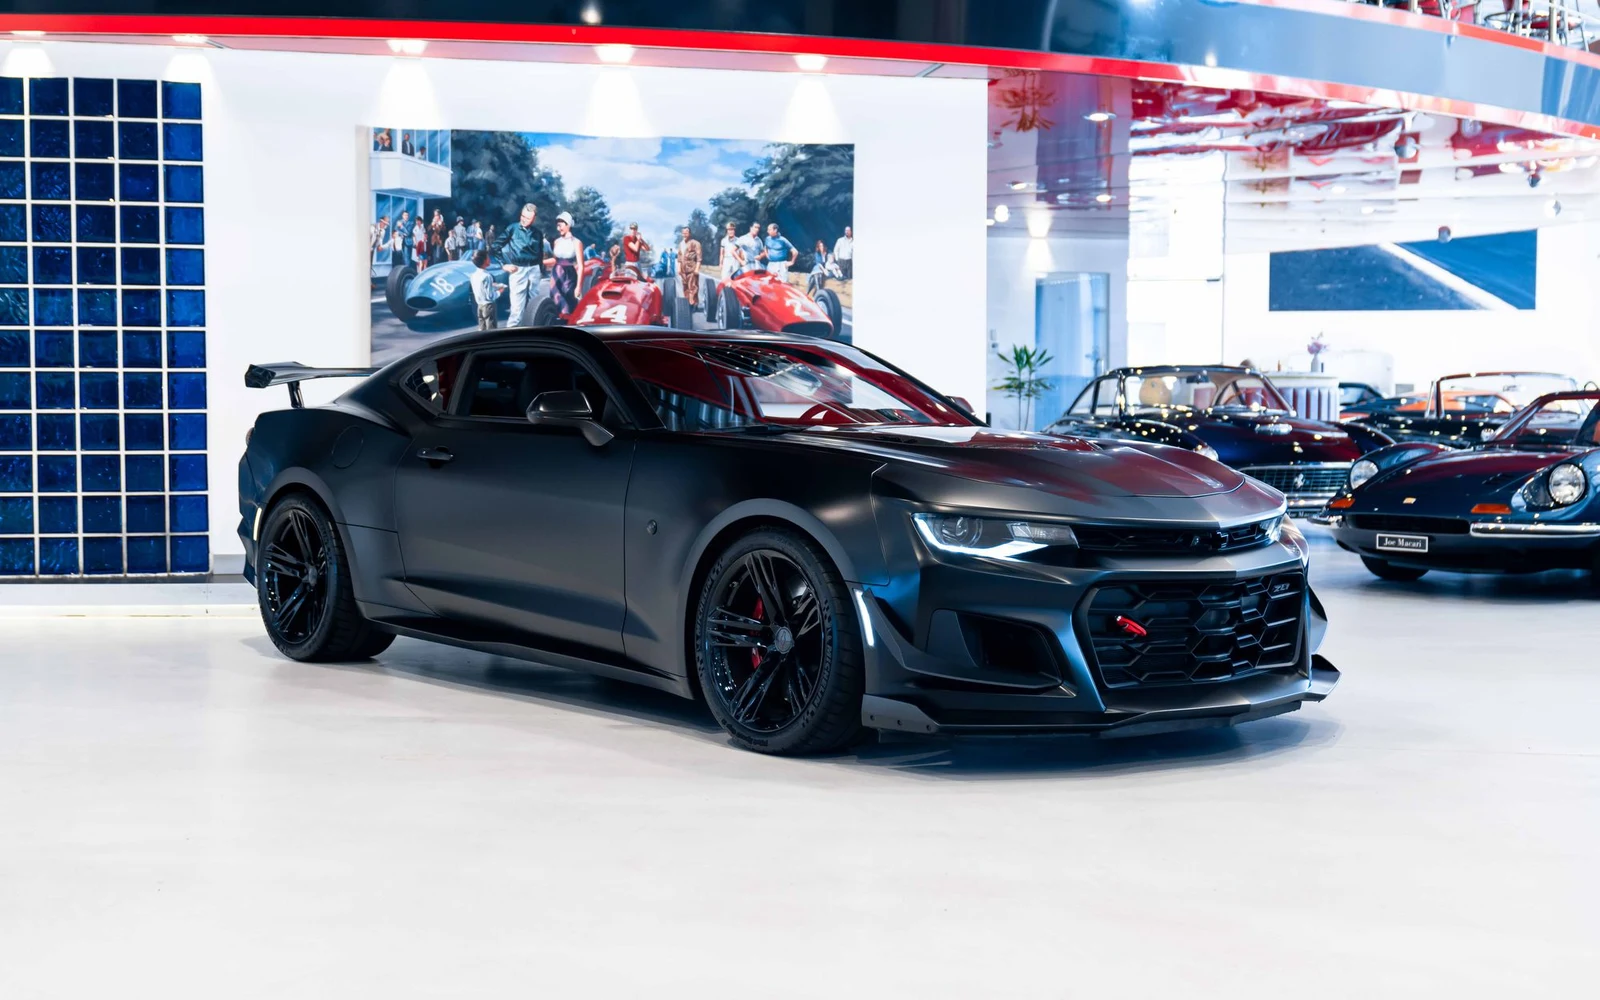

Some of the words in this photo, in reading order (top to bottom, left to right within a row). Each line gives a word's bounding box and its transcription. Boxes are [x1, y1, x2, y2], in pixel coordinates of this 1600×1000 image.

[429, 276, 455, 296] 18
[576, 303, 628, 325] 14
[1383, 537, 1396, 546] Joe
[1397, 538, 1422, 548] Macari
[1273, 583, 1290, 592] ZL1
[812, 645, 833, 708] MICHELIN
